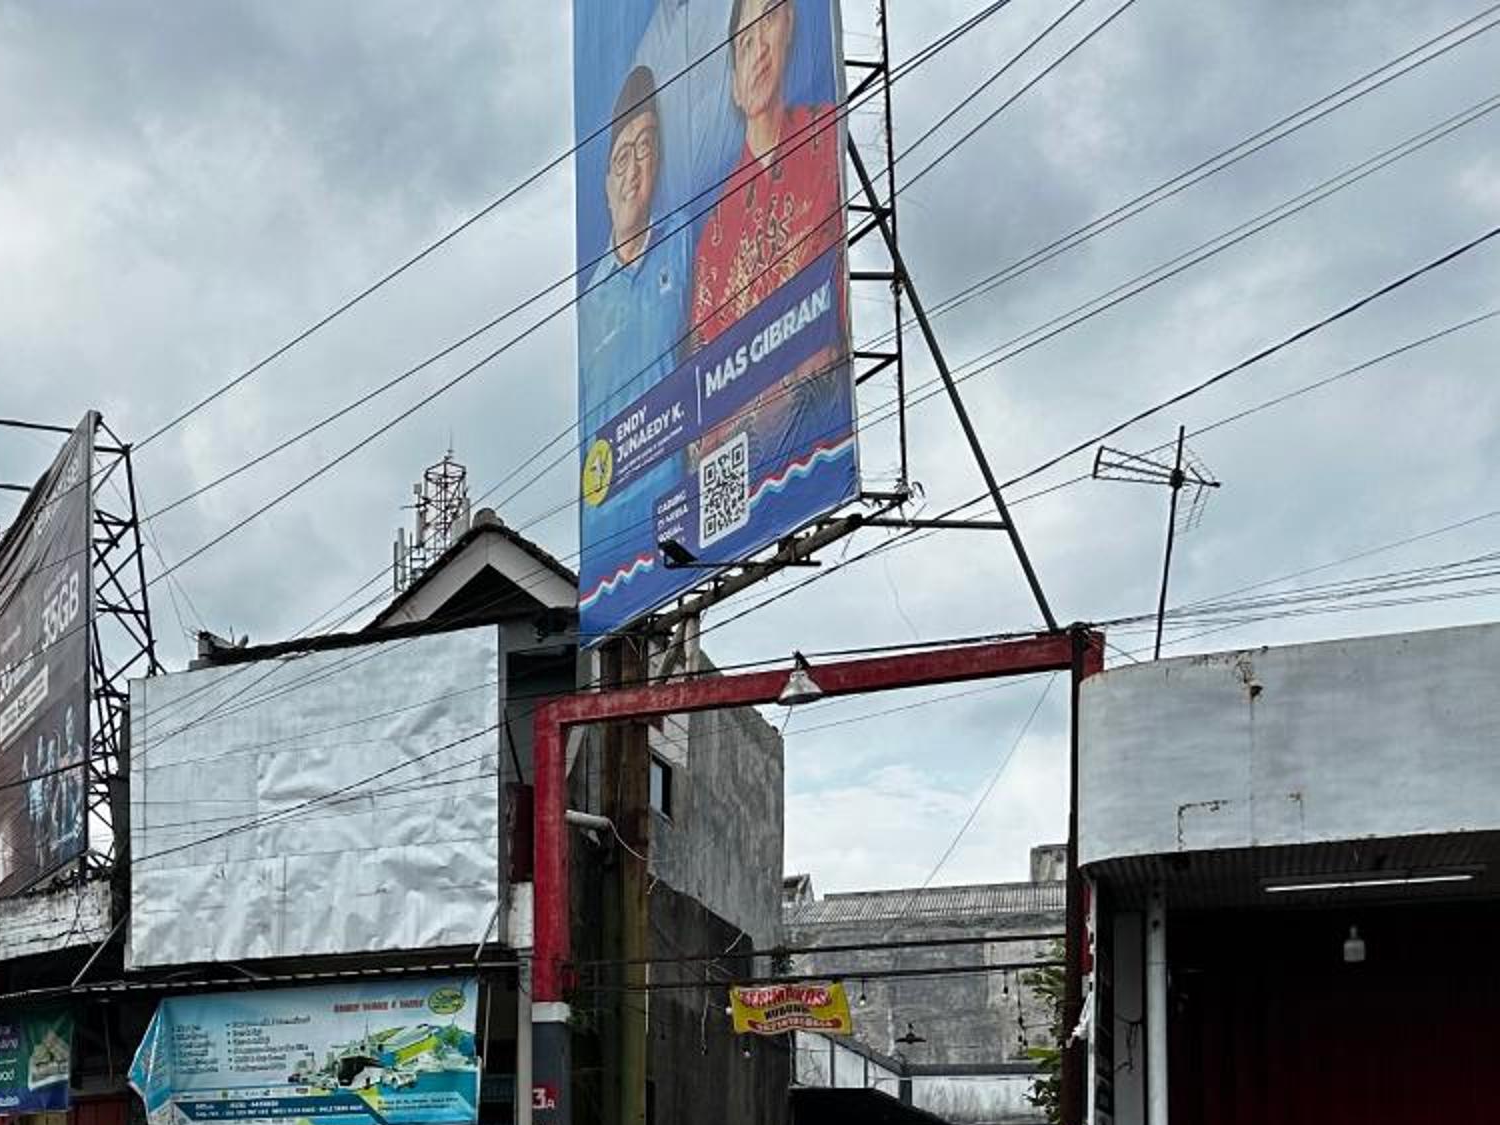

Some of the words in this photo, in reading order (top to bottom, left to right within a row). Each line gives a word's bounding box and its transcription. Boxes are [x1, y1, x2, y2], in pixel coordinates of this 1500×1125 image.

[705, 351, 748, 399] MAS
[750, 284, 831, 364] GIBRAN
[615, 404, 647, 443] ENDY
